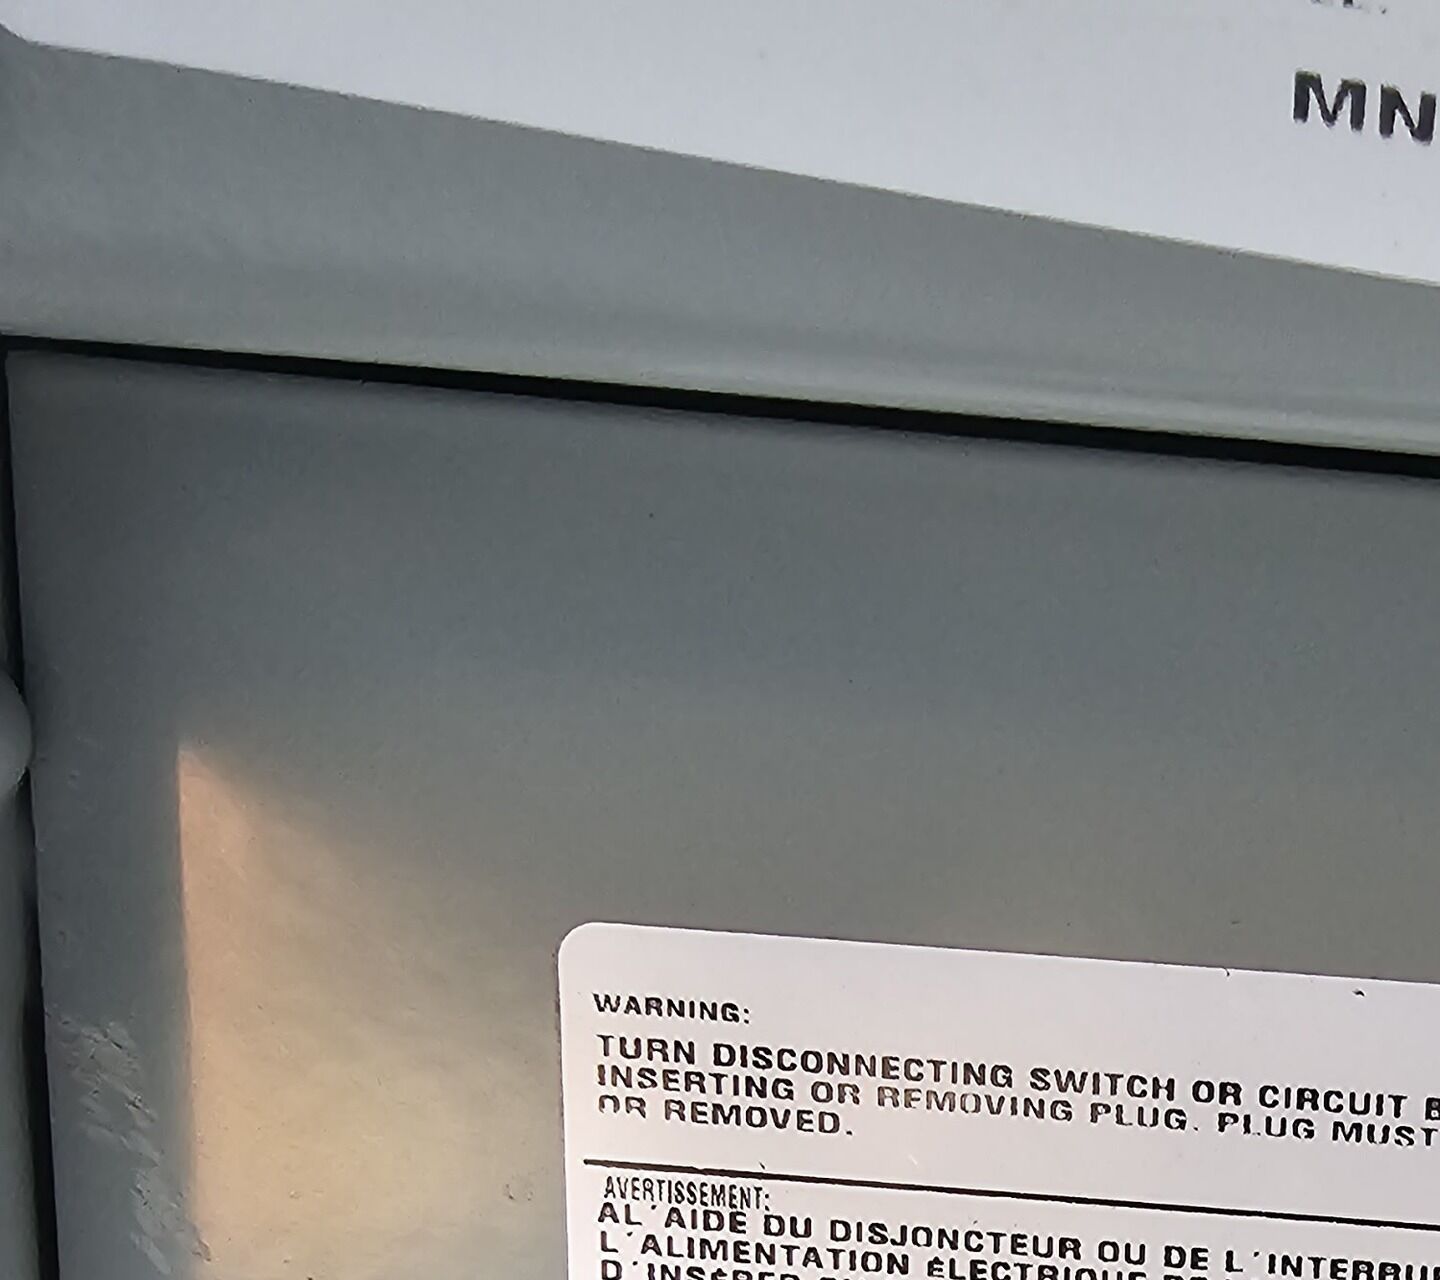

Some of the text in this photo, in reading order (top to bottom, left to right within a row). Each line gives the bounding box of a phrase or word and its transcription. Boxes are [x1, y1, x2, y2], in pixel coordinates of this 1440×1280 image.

[591, 991, 751, 1026] WARNING:
[595, 1033, 696, 1067] TURN
[712, 1041, 1014, 1090] DISCONNECTING
[1028, 1066, 1176, 1103] SWITCH
[1190, 1078, 1244, 1108] OR
[1257, 1083, 1409, 1120] CIRCUIT
[596, 1062, 796, 1102] INSERTING
[810, 1079, 861, 1106] OR
[876, 1084, 1074, 1123] REMOVING
[1088, 1101, 1200, 1132] PLUG.
[1216, 1110, 1316, 1141] PLUG
[1330, 1119, 1440, 1148] MUST
[597, 1093, 854, 1137] OR REMOVED.
[602, 1174, 771, 1213] AVERTISSEMENT:
[762, 1212, 813, 1240] DU
[828, 1218, 1083, 1262] DISJONCTEUR
[1096, 1239, 1147, 1267] OU
[1162, 1244, 1210, 1272] DE
